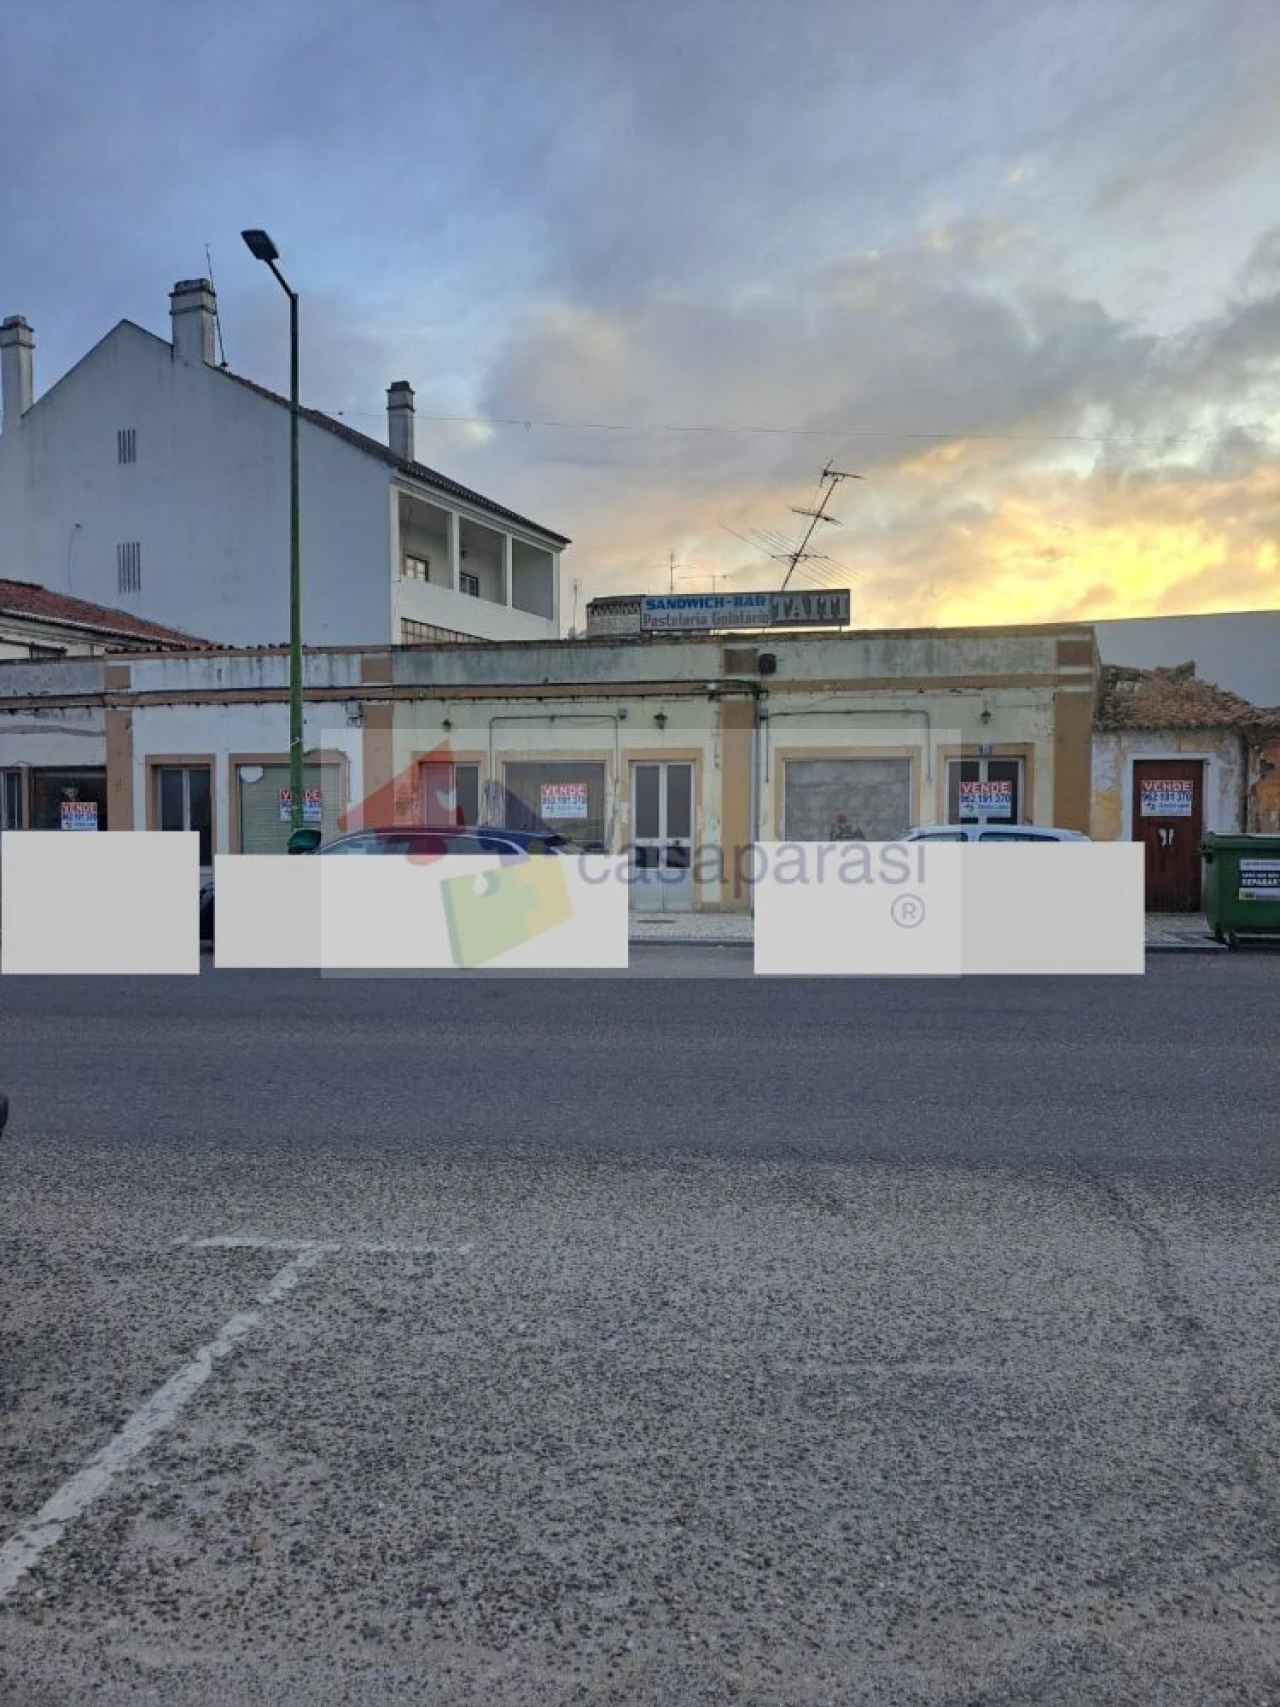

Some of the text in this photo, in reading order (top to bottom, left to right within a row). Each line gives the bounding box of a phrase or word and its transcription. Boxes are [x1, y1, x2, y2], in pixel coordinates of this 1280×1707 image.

[645, 596, 765, 610] SANDWICH-BAR
[773, 594, 848, 620] TAITI
[544, 785, 585, 795] VENDE
[961, 782, 1010, 793] VENDE
[1144, 781, 1191, 791] VENDE
[63, 803, 97, 813] VENDE
